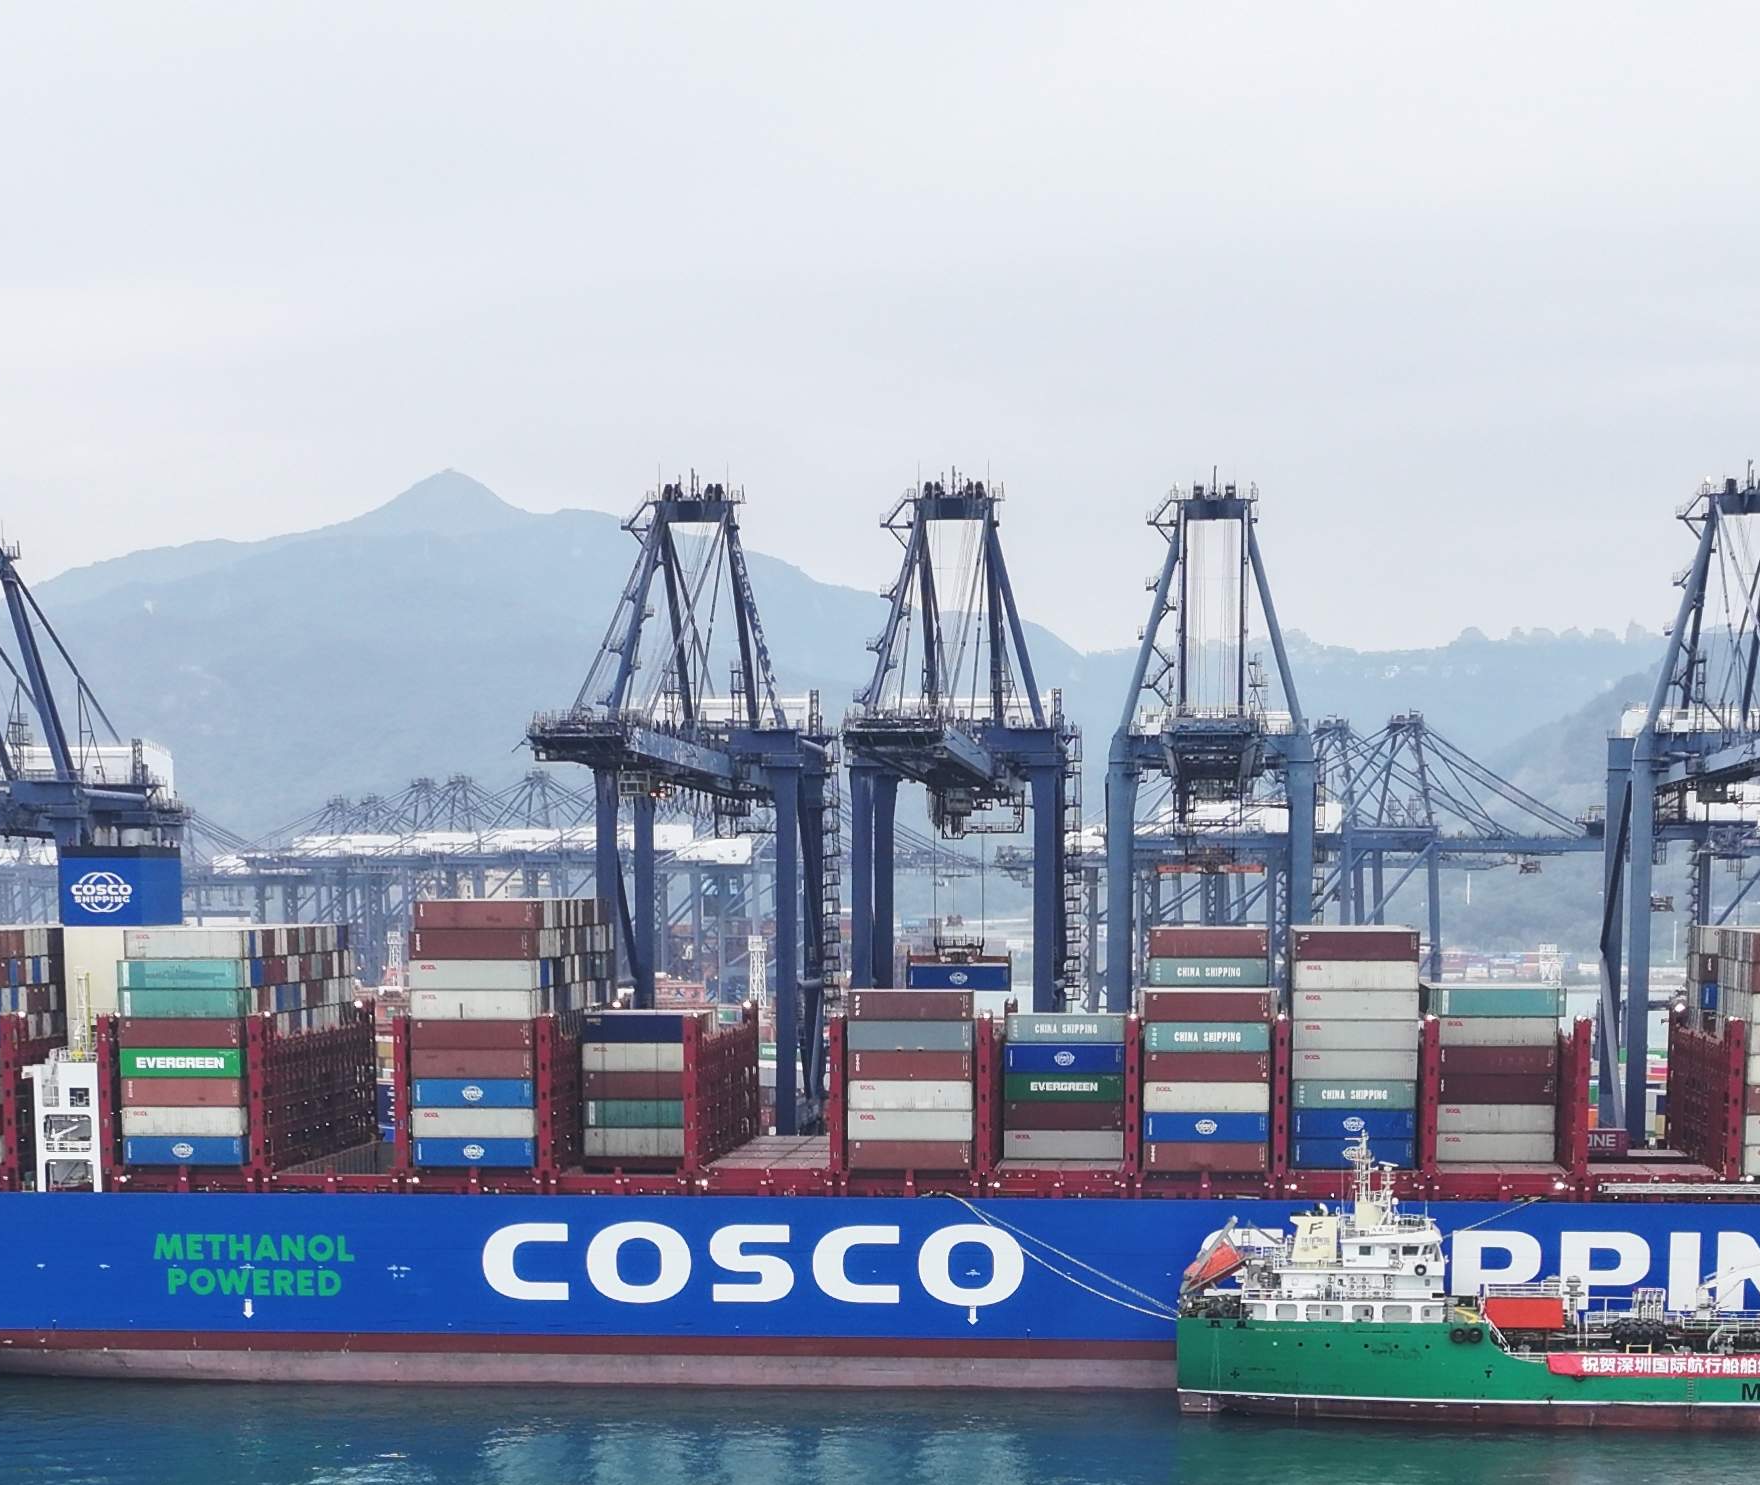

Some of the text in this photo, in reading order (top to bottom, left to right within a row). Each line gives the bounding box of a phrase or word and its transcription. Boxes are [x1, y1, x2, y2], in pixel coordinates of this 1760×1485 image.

[70, 883, 133, 896] COSCO
[74, 895, 130, 904] SHIPPING
[1177, 967, 1241, 978] CHINA SHIPPING
[1035, 1023, 1098, 1035] CHINA SHIPPING
[1174, 1031, 1241, 1043] CHINA SHIPPING
[136, 1056, 225, 1069] EVERGREEN
[1029, 1081, 1099, 1092] EVERGREEN
[1321, 1089, 1345, 1101] CHINA
[1350, 1089, 1388, 1101] SHIPPING
[1587, 1135, 1617, 1148] NE
[153, 1232, 355, 1262] METHANOL
[482, 1221, 1025, 1307] COSCO
[167, 1266, 344, 1298] POWERED
